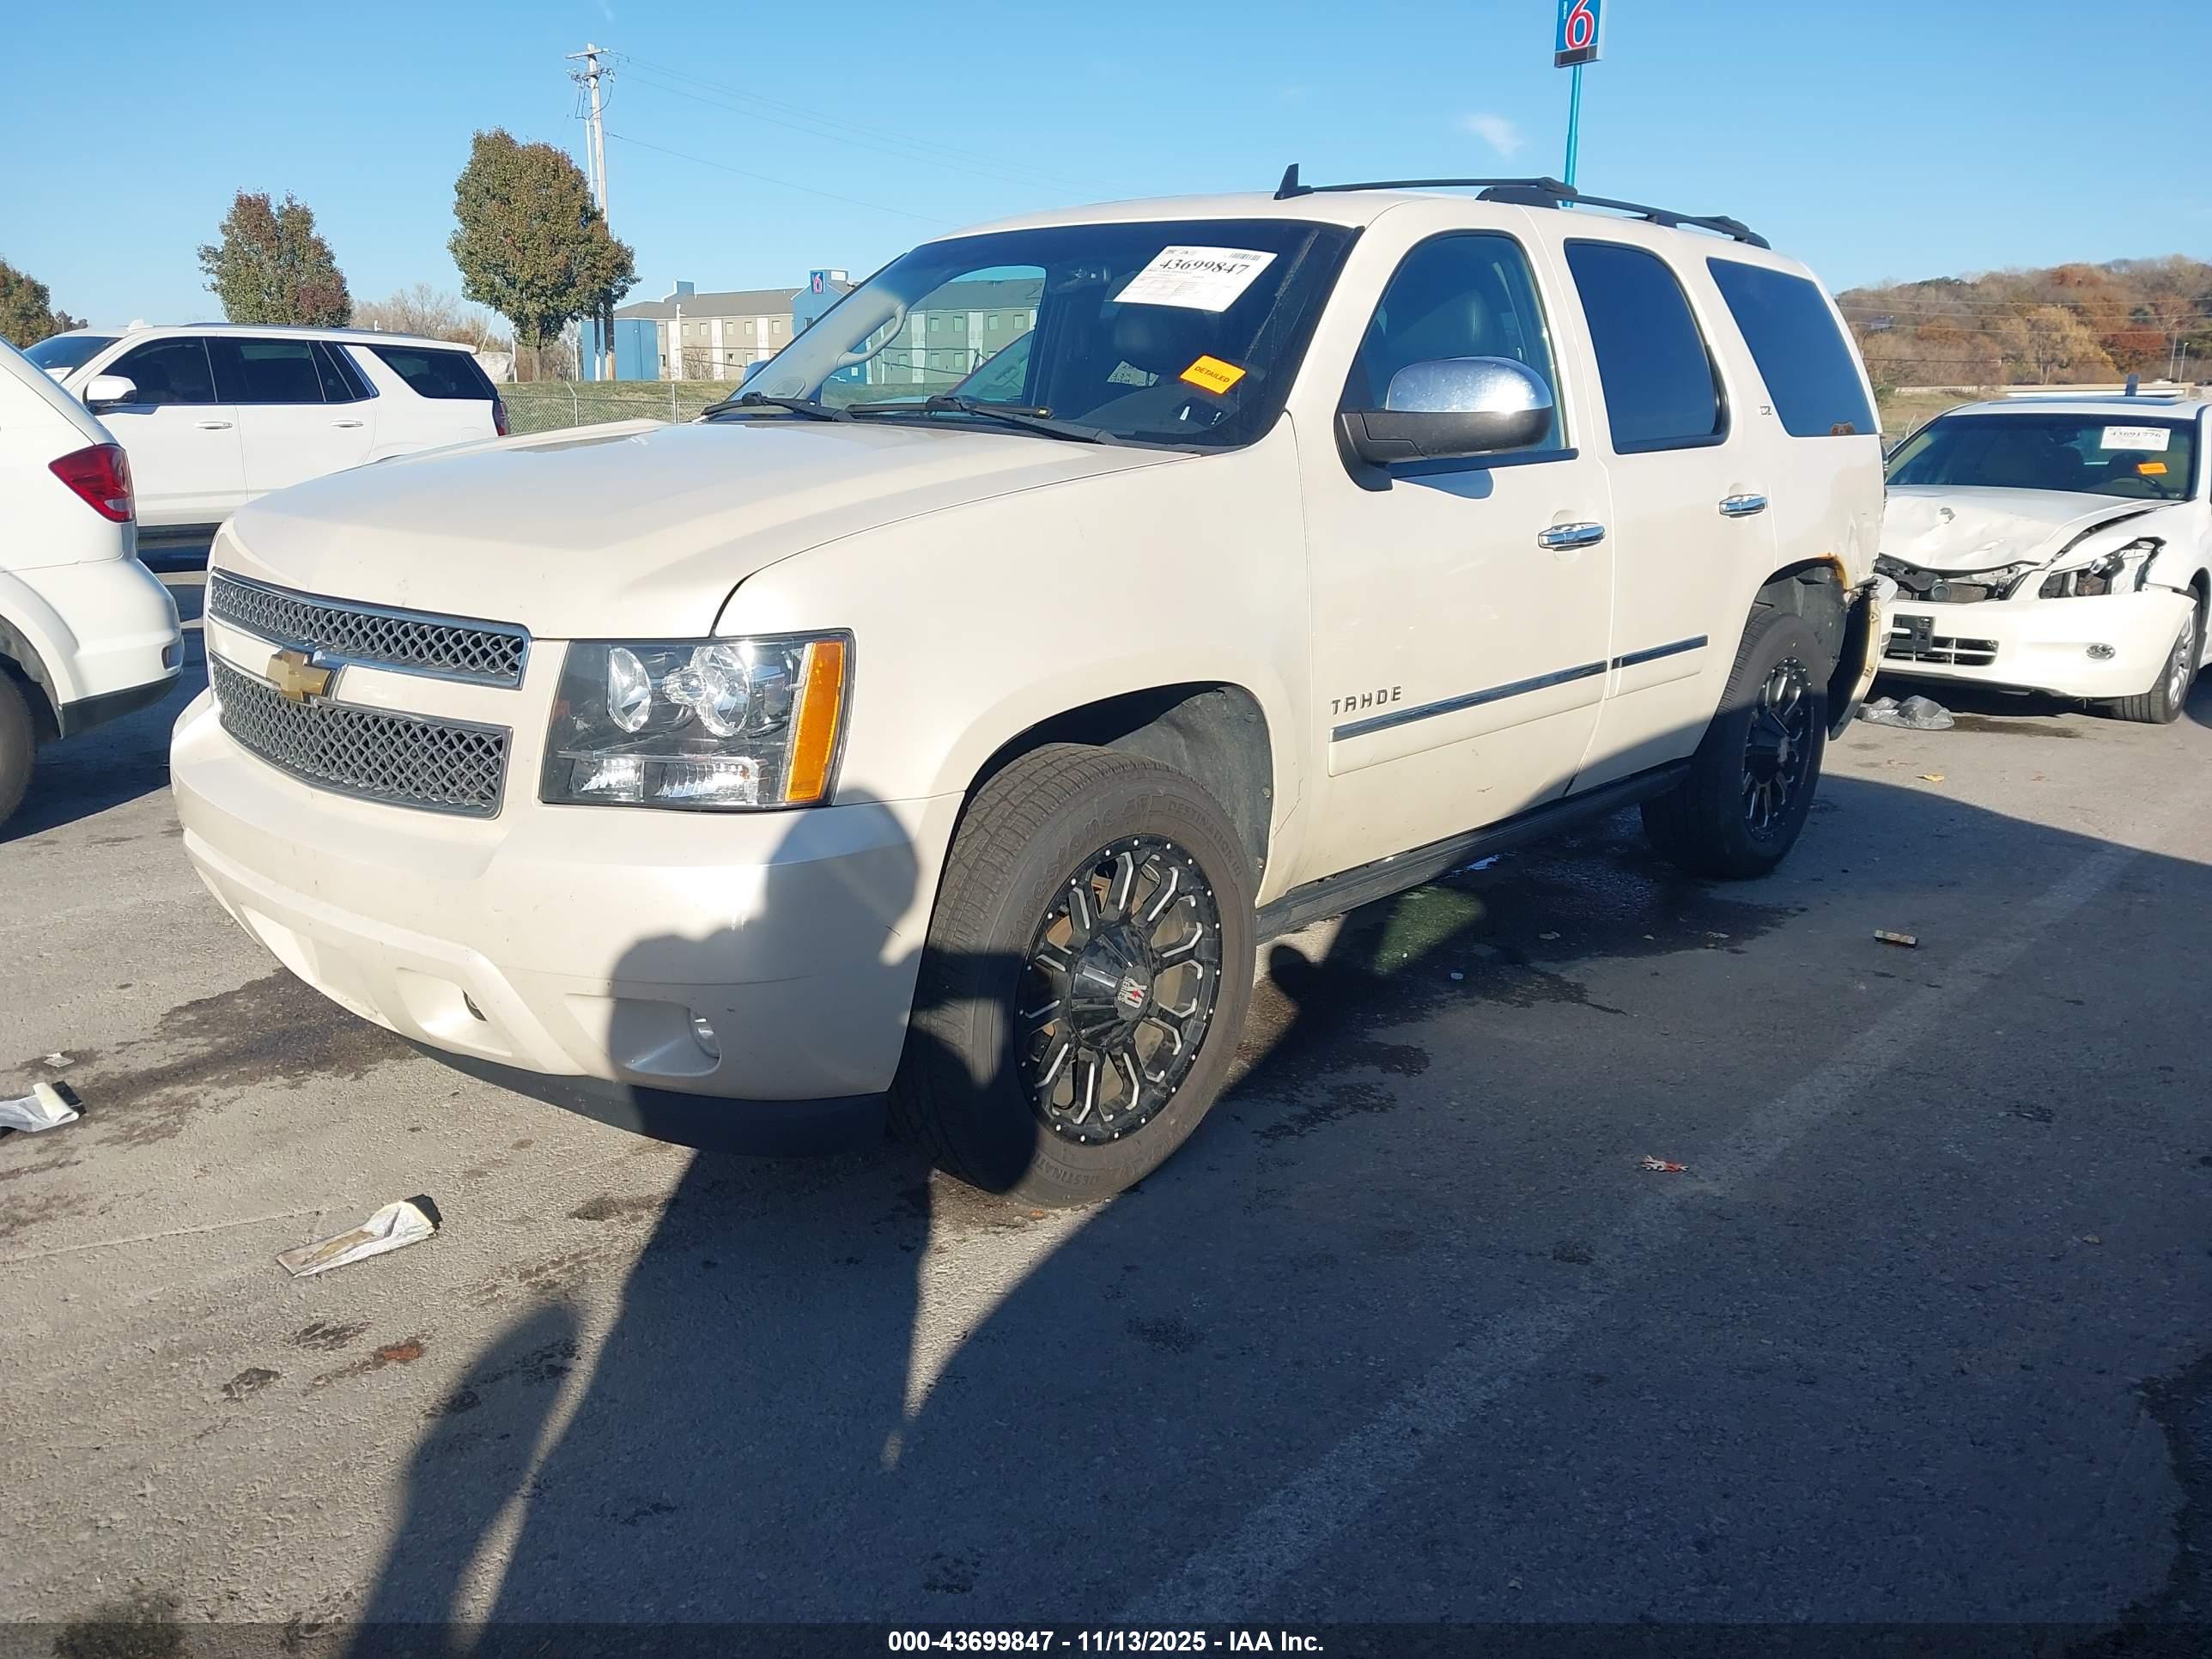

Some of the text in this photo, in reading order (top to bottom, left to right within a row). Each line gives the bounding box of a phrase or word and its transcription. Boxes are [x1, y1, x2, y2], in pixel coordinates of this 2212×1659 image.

[1565, 0, 1595, 49] 6
[1159, 258, 1250, 275] 43699847
[1194, 366, 1231, 383] DETAILED
[1332, 685, 1401, 714] TAHOE
